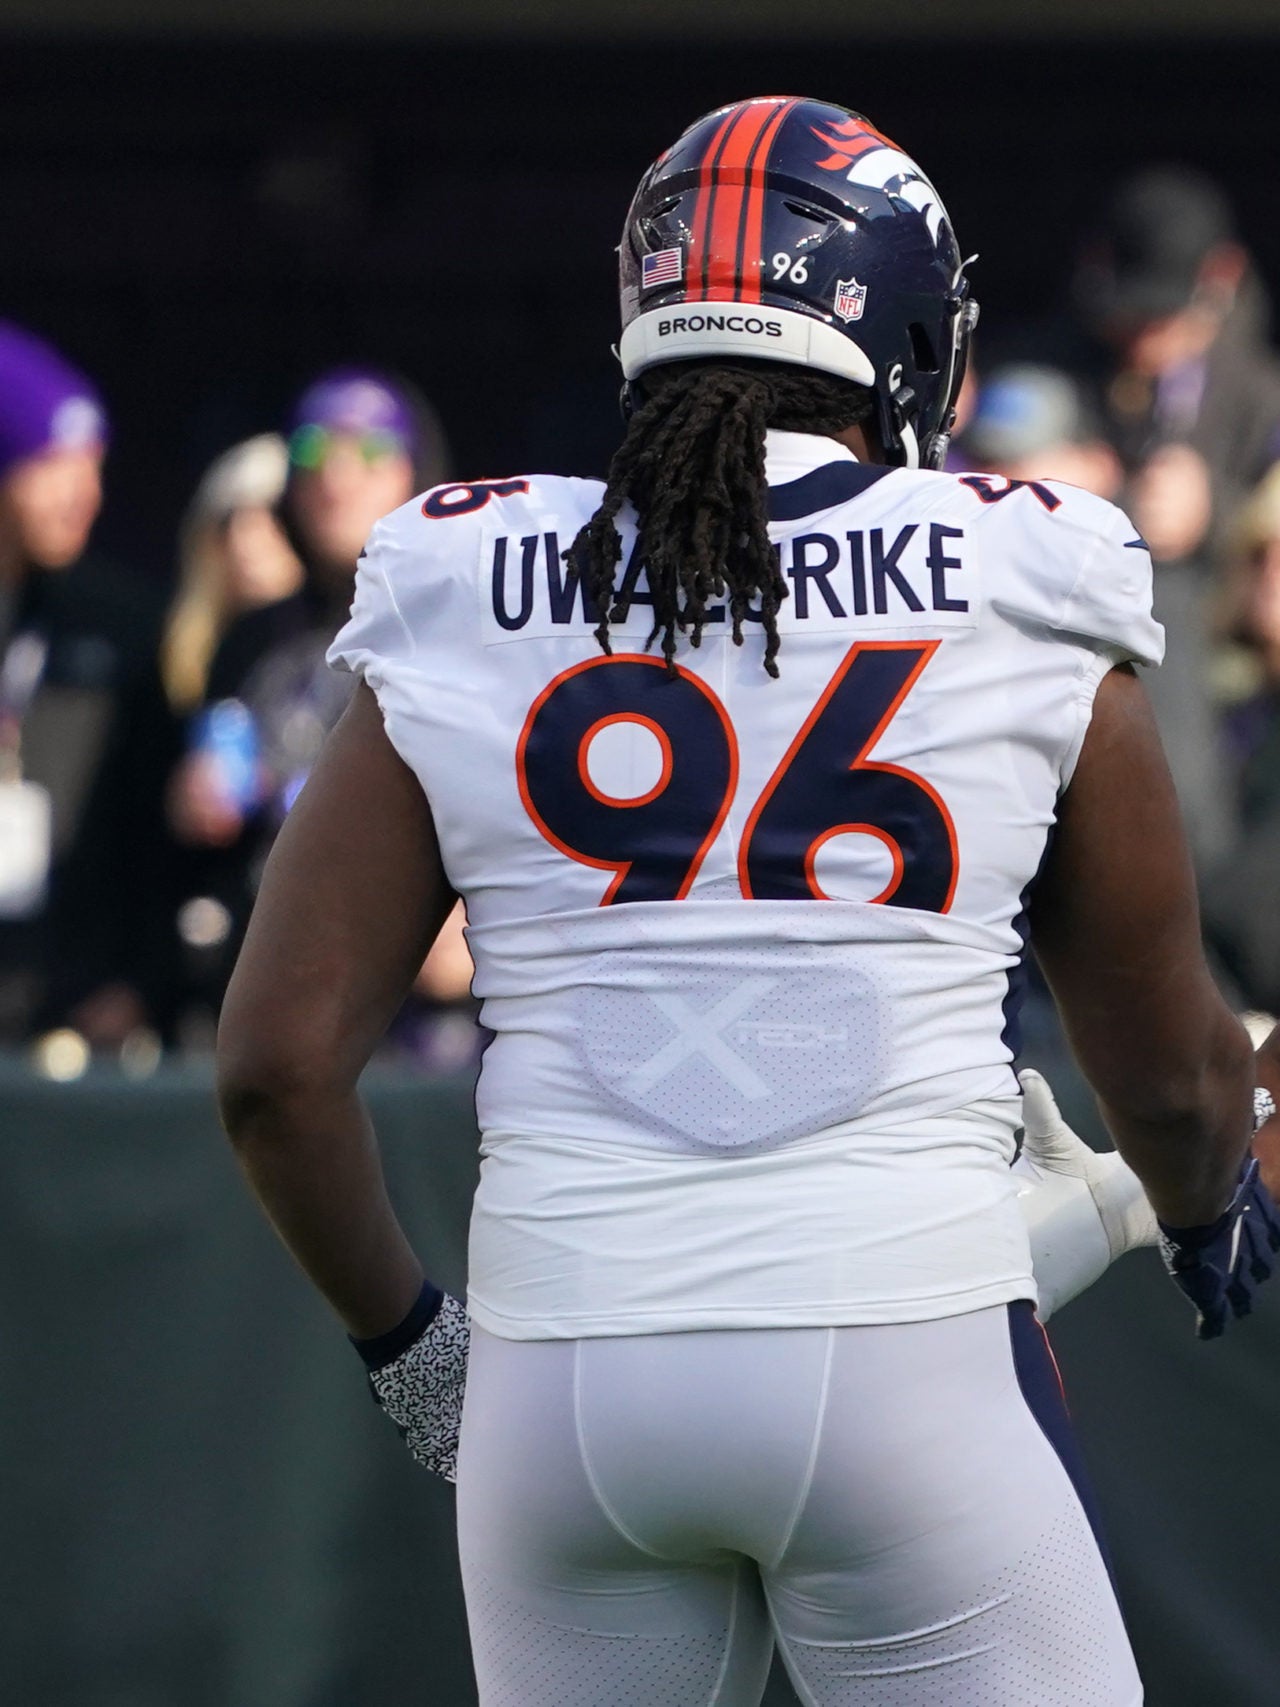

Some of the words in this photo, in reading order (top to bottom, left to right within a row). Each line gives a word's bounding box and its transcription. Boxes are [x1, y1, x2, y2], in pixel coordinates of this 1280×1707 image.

[772, 252, 807, 283] 96
[837, 297, 861, 315] NFL
[658, 315, 782, 337] BRONCOS
[515, 639, 957, 914] 96
